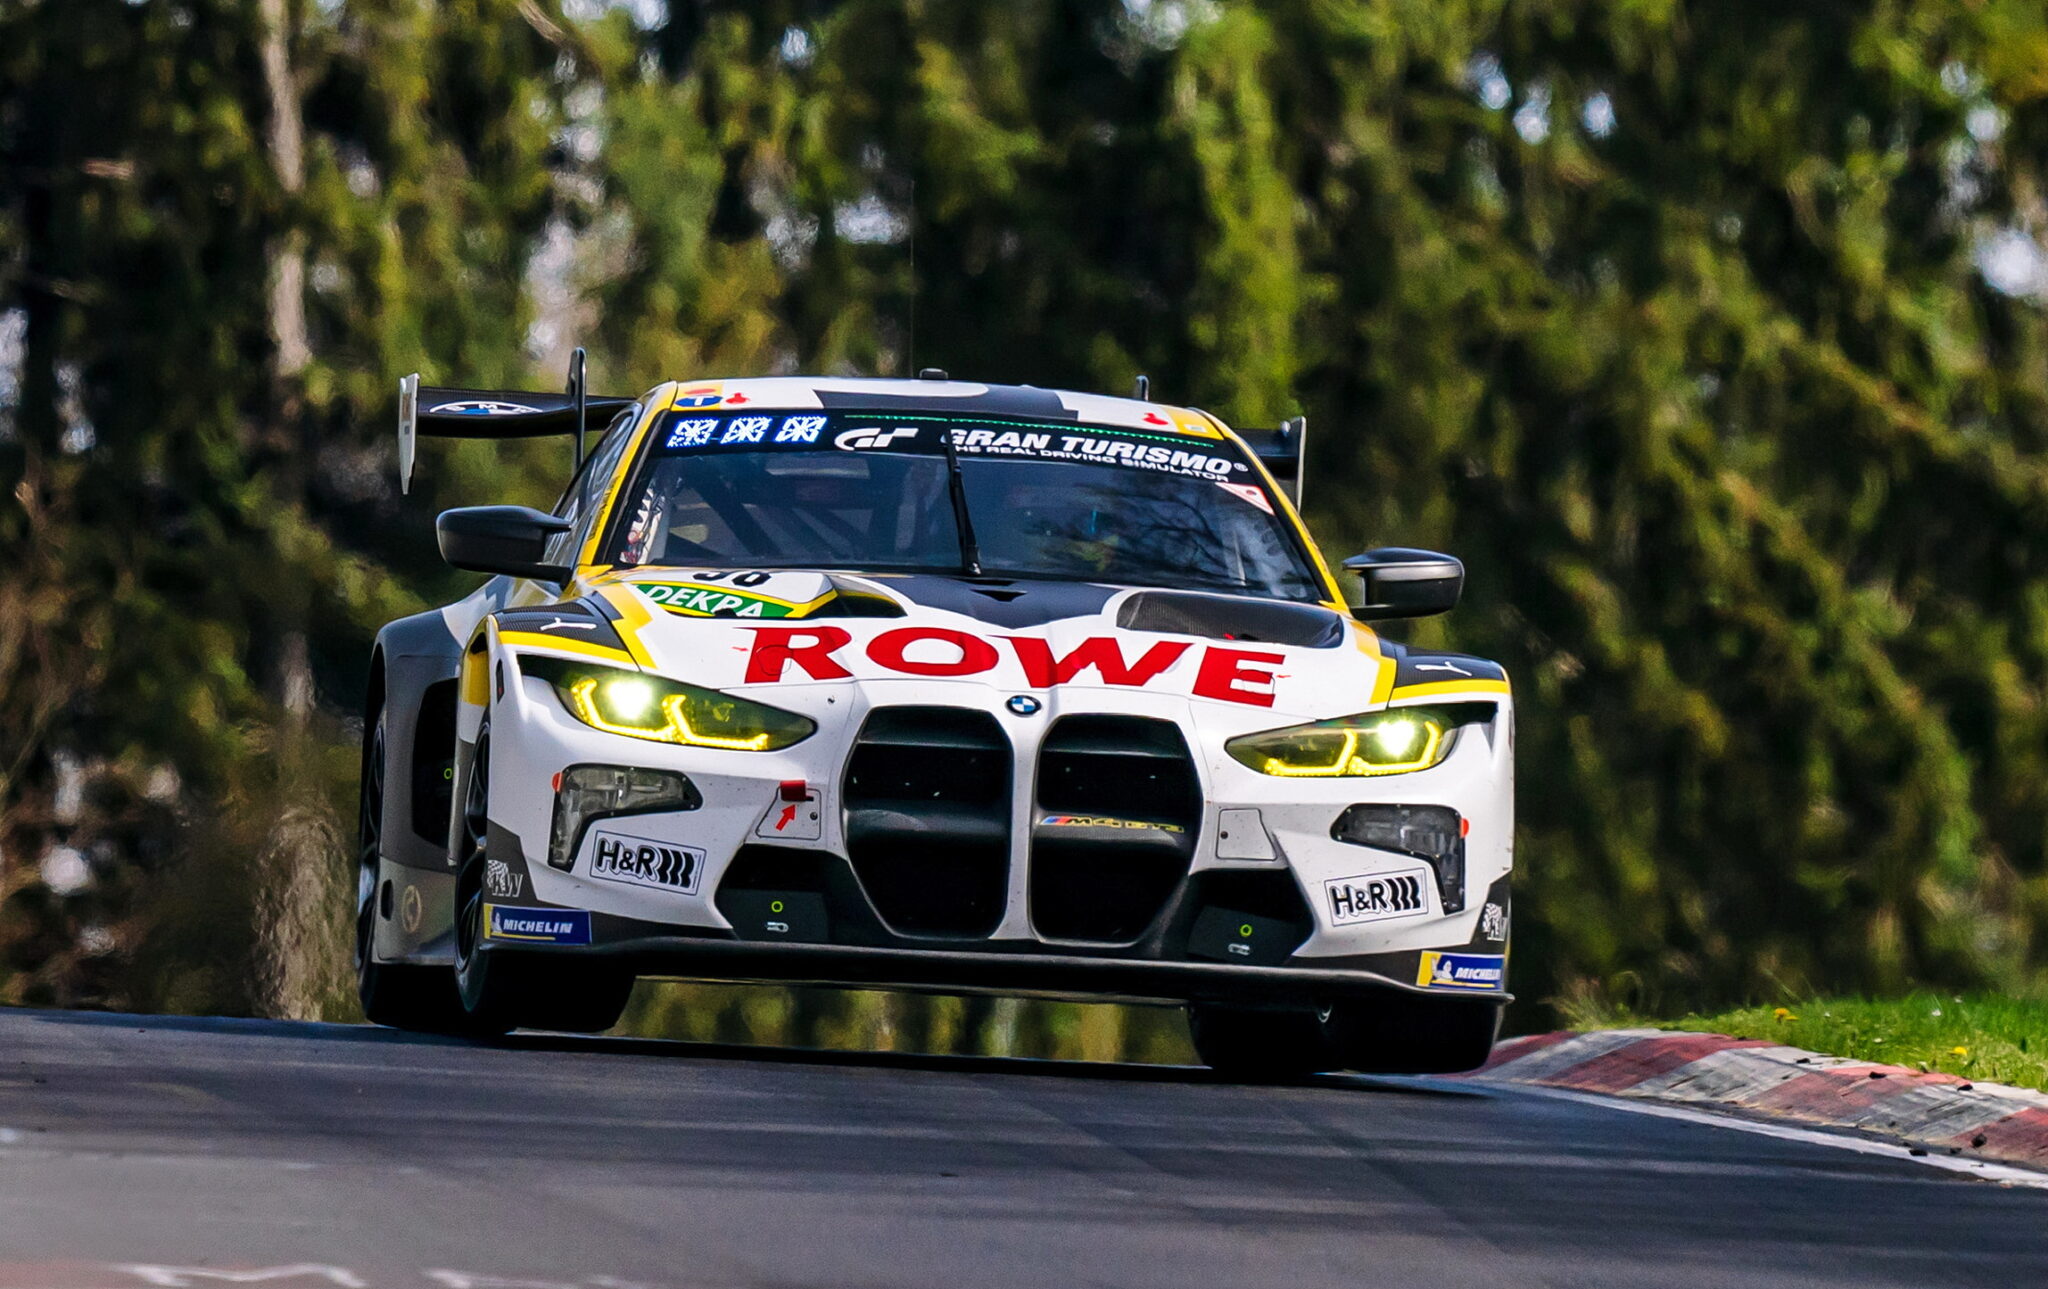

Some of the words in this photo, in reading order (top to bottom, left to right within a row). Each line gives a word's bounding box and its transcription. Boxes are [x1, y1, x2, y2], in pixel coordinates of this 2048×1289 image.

[834, 427, 919, 451] GT
[940, 428, 1052, 449] GRAN
[954, 445, 982, 453] HE
[986, 446, 1037, 456] REAL
[1040, 450, 1117, 464] DRIVING
[1120, 459, 1229, 482] SIMULATOR
[733, 625, 1287, 708] ROWE
[597, 838, 658, 881] H&R
[1330, 880, 1392, 919] H&R
[503, 918, 574, 934] MICHELIN
